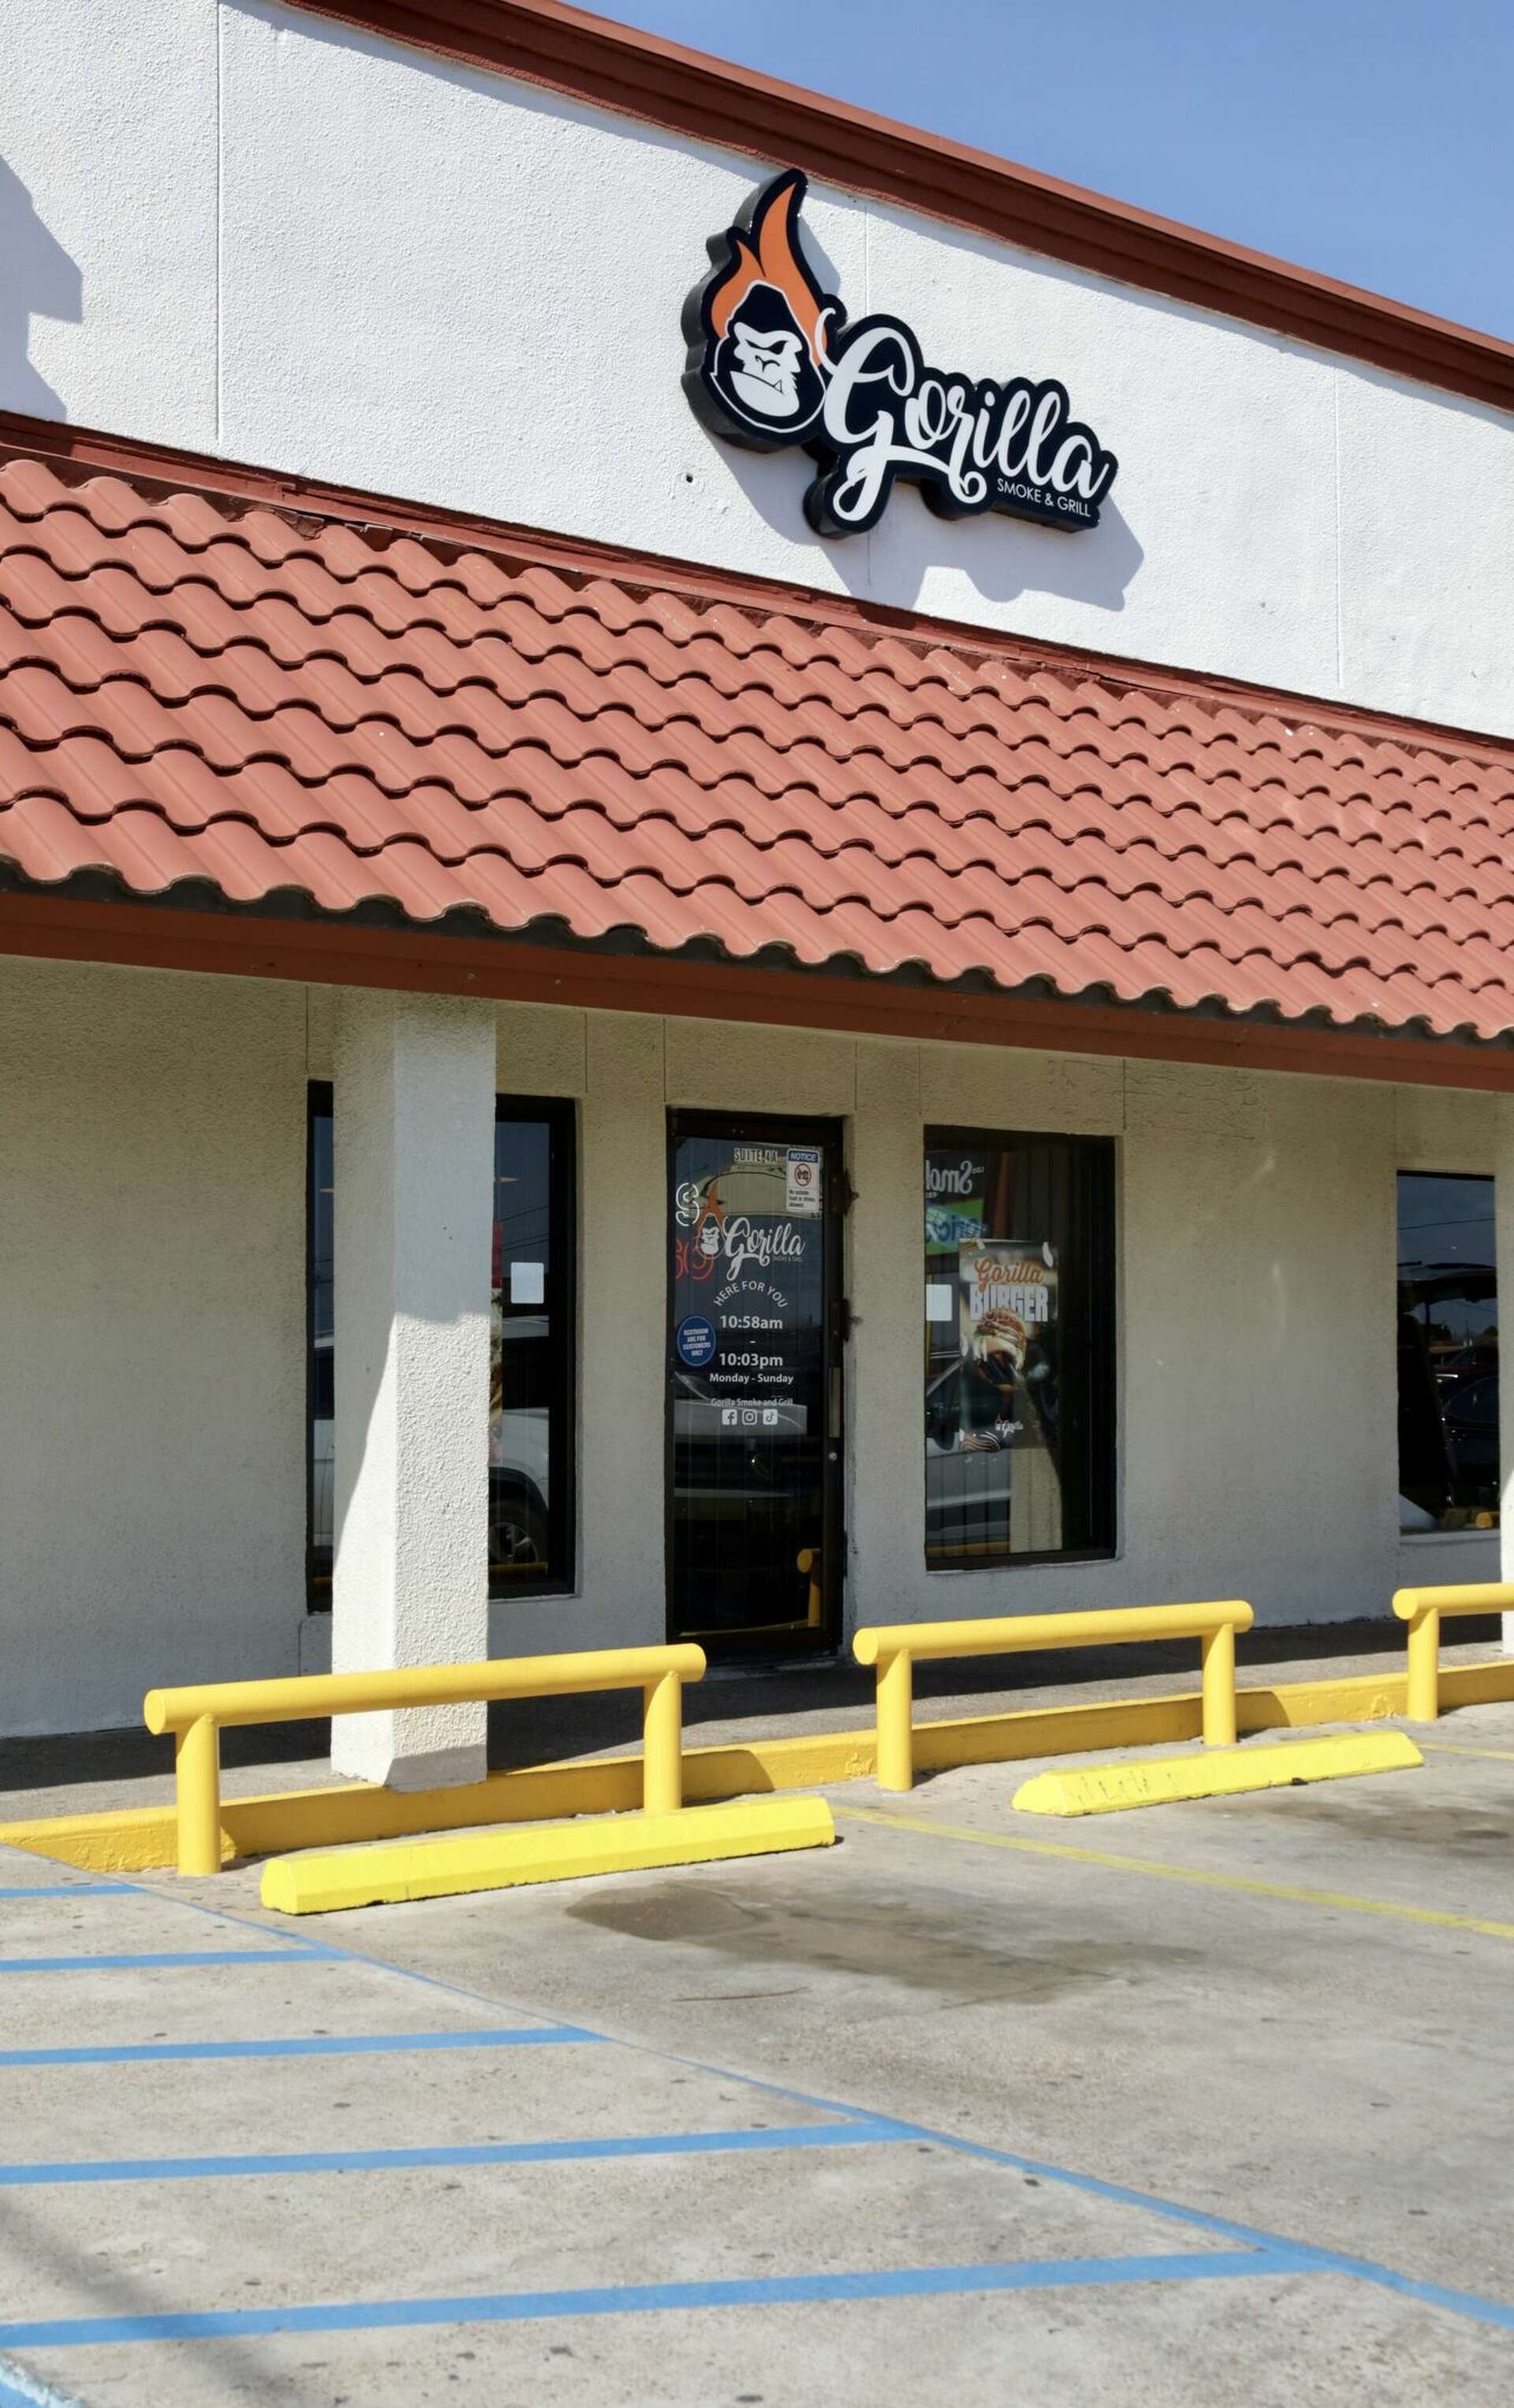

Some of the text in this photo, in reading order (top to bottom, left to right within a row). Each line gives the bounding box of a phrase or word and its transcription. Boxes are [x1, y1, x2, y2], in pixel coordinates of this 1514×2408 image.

[815, 307, 1109, 521] Gorilla
[997, 477, 1091, 518] SMOKE & GRILL
[790, 1152, 817, 1162] NOTICE
[722, 1216, 806, 1282] Gorilla
[975, 1256, 1044, 1293] Gorilla
[713, 1280, 789, 1308] HERE FOR YOU
[970, 1283, 1049, 1322] BURGER
[720, 1315, 783, 1329] 10:58am
[719, 1353, 783, 1369] 10:03pm
[709, 1373, 749, 1385] Monday
[757, 1373, 794, 1385] Sunday
[710, 1398, 793, 1407] Gorilla Smoke and Grill
